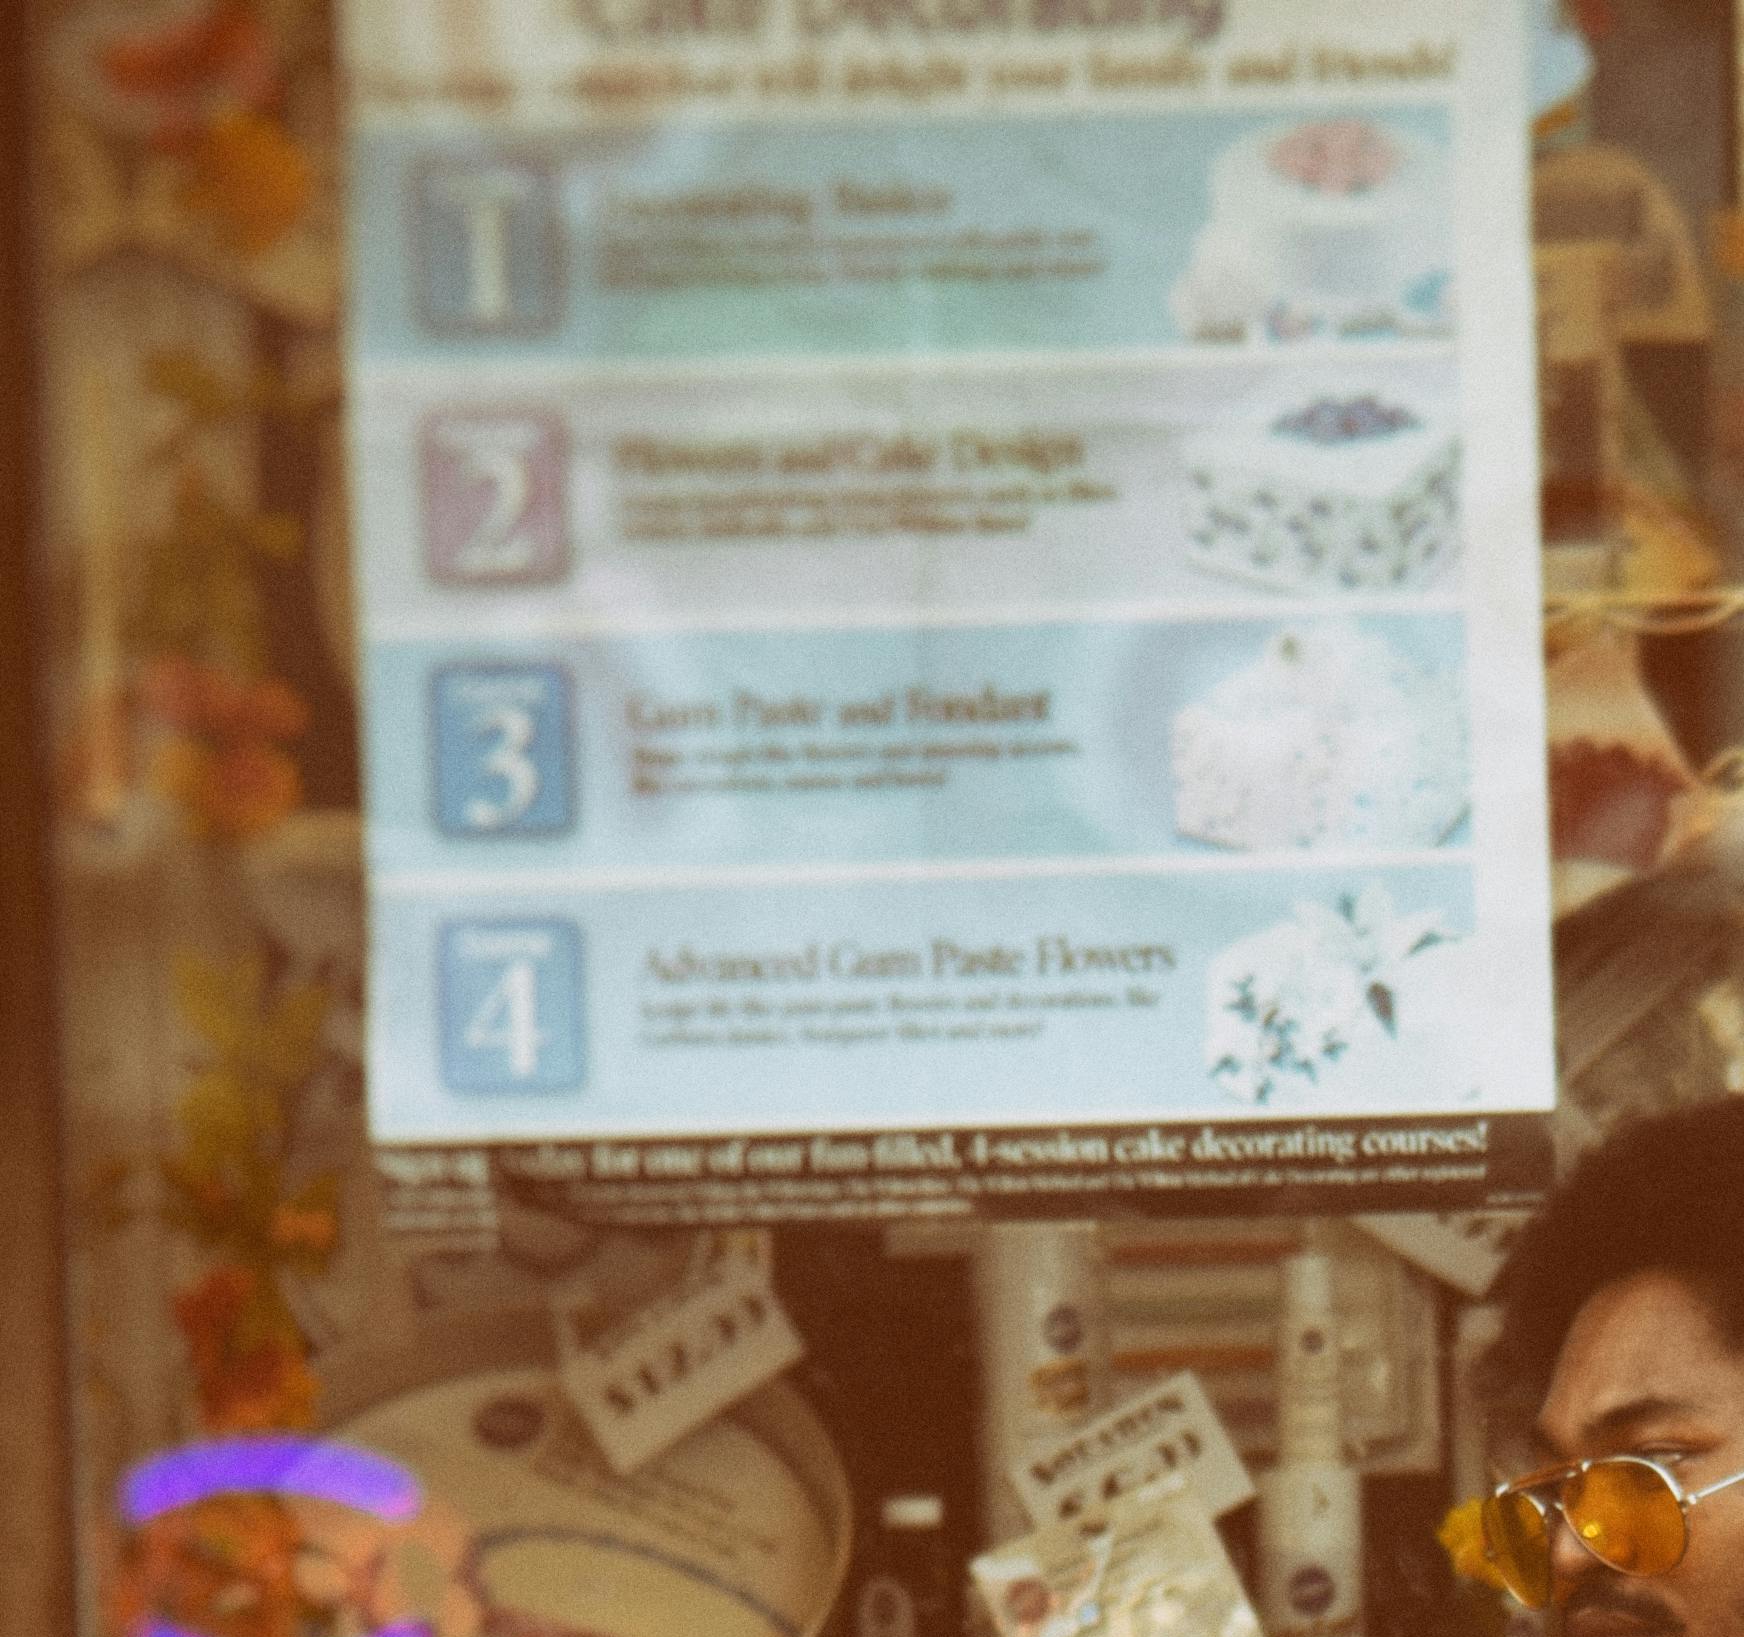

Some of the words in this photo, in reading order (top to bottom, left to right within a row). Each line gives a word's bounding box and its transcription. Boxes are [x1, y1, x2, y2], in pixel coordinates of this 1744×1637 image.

[462, 704, 540, 828] 3
[643, 938, 820, 985] Advanced
[826, 936, 924, 980] Gum
[930, 934, 1026, 980] Paste
[1034, 932, 1178, 976] Flowers
[464, 958, 550, 1078] 4
[1114, 1128, 1186, 1164] cake
[1192, 1124, 1358, 1166] decorating
[1360, 1118, 1490, 1159] courses!
